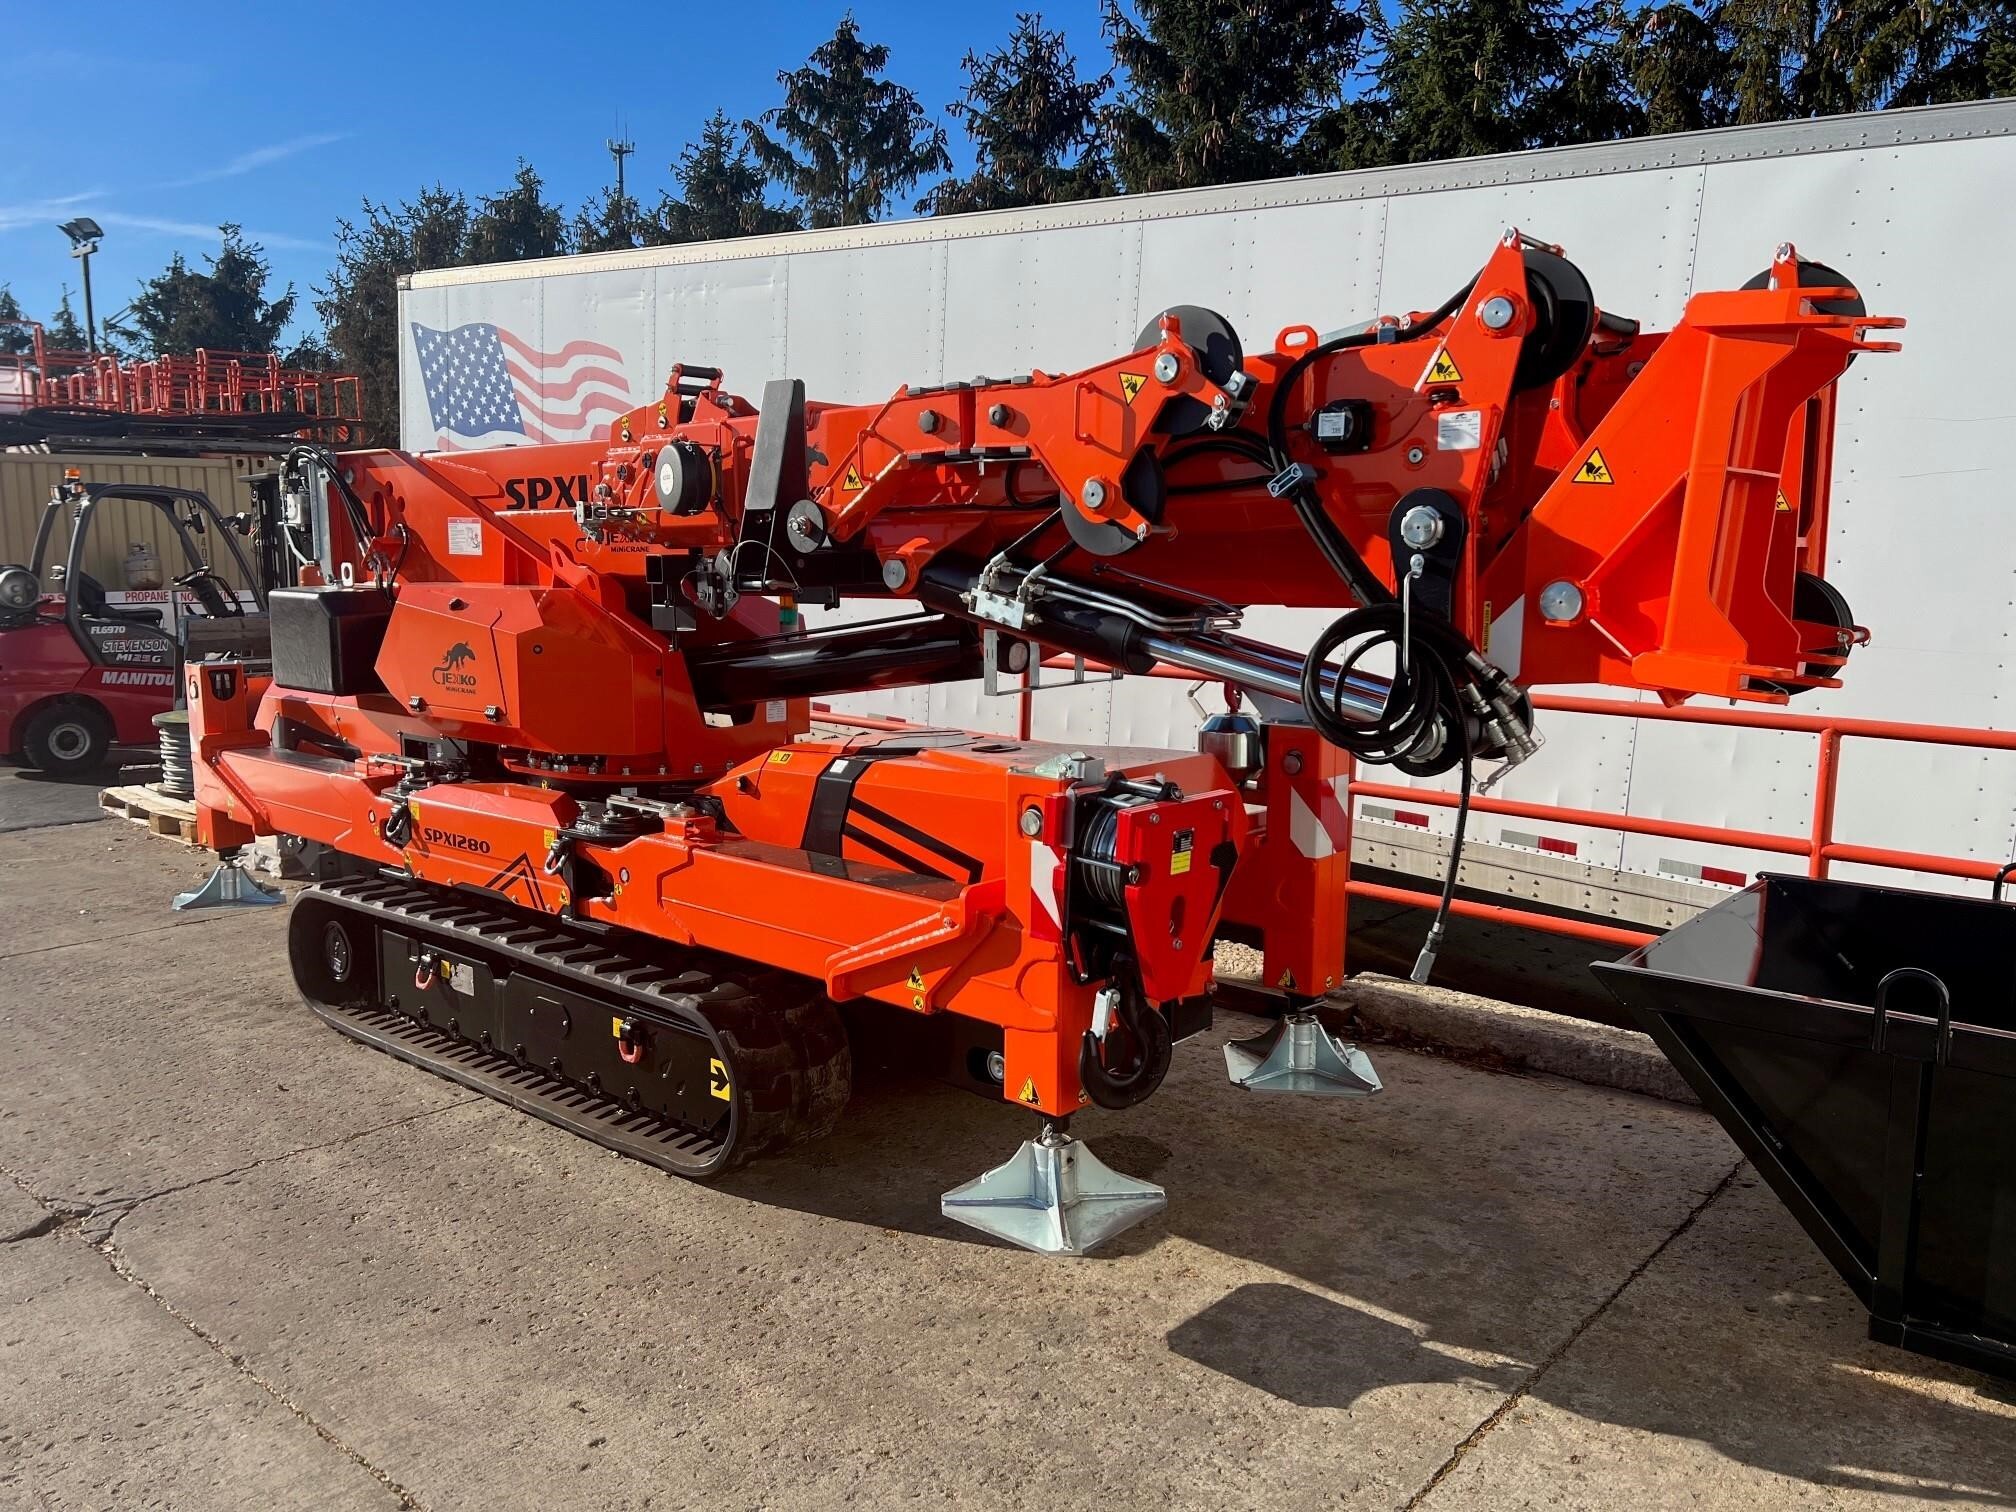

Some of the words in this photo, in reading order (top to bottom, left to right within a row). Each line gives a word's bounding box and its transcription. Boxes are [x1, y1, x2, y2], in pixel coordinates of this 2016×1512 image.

[125, 591, 169, 602] PROPANE
[180, 592, 194, 602] NO
[90, 625, 126, 634] FL6970
[102, 639, 169, 653] STEVENSON
[101, 671, 174, 686] MANITOU
[424, 827, 491, 854] SPX1280
